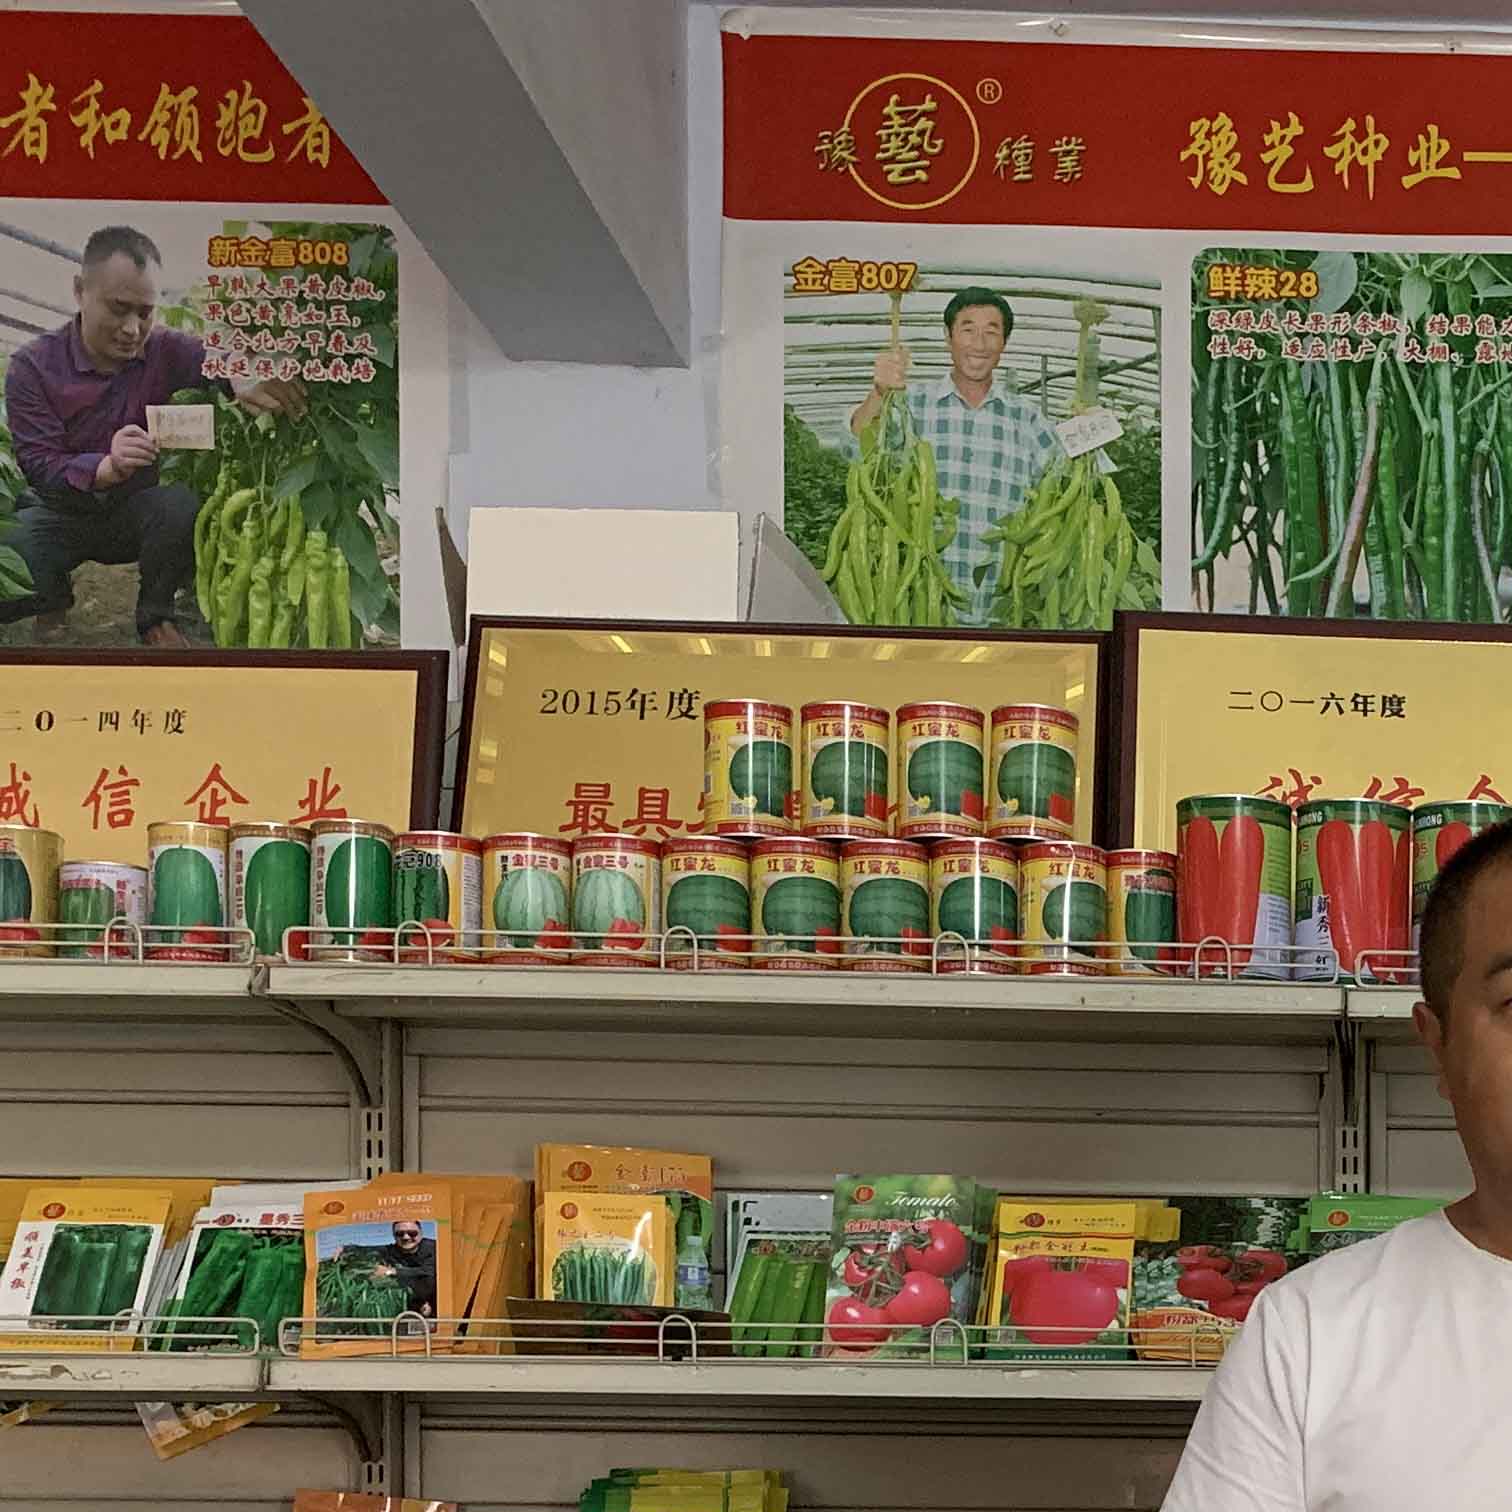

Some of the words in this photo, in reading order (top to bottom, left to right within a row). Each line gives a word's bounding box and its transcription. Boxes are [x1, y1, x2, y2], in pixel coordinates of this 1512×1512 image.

[208, 236, 349, 267] 新金富808
[792, 255, 918, 292] 金富807
[1207, 264, 1319, 300] 鲜辣28
[540, 687, 701, 721] 2015年度
